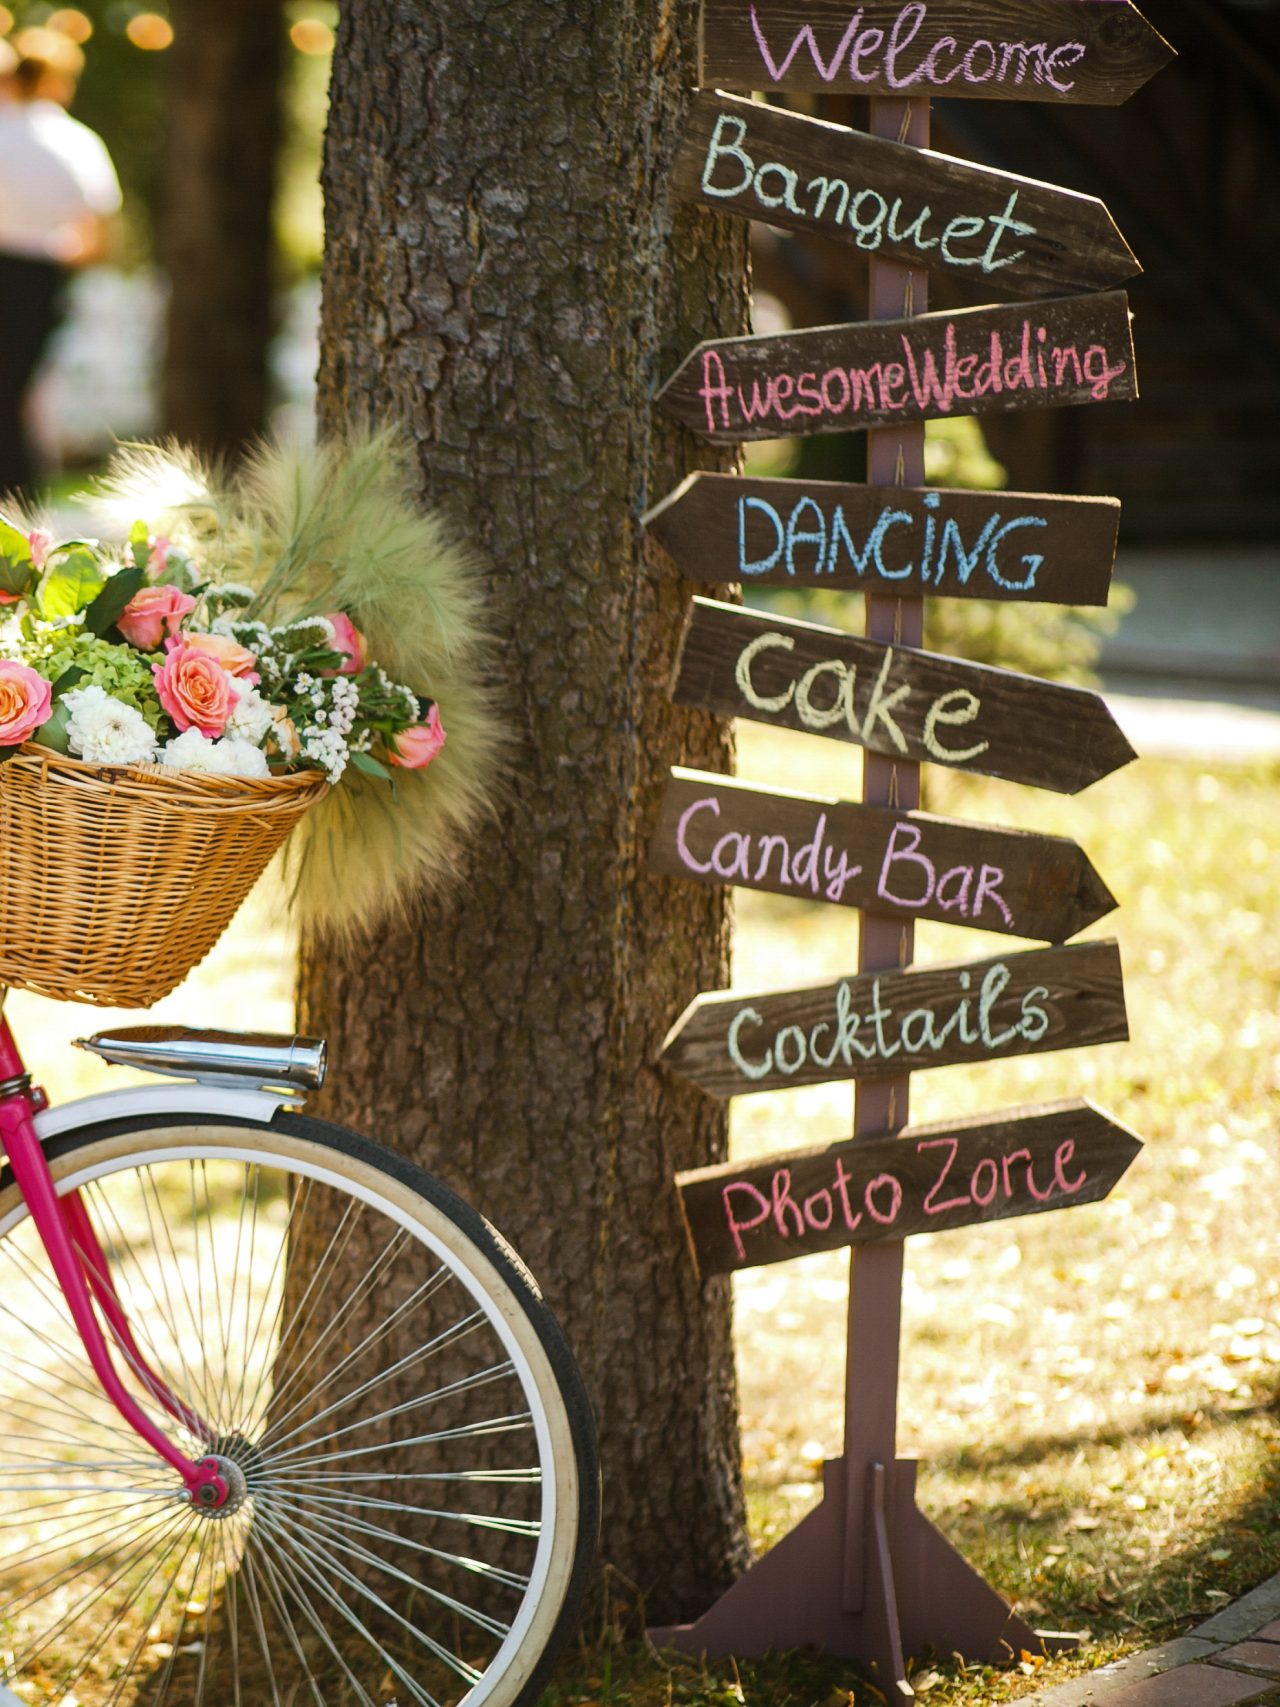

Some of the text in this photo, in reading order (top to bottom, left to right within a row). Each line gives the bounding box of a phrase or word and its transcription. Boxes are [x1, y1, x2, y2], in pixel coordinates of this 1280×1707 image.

[750, 2, 1087, 93] Welcome
[734, 632, 990, 763] Cake
[676, 797, 862, 901] Candy
[727, 962, 1049, 1079] Cocktails
[721, 1137, 1087, 1261] Photo Zone
